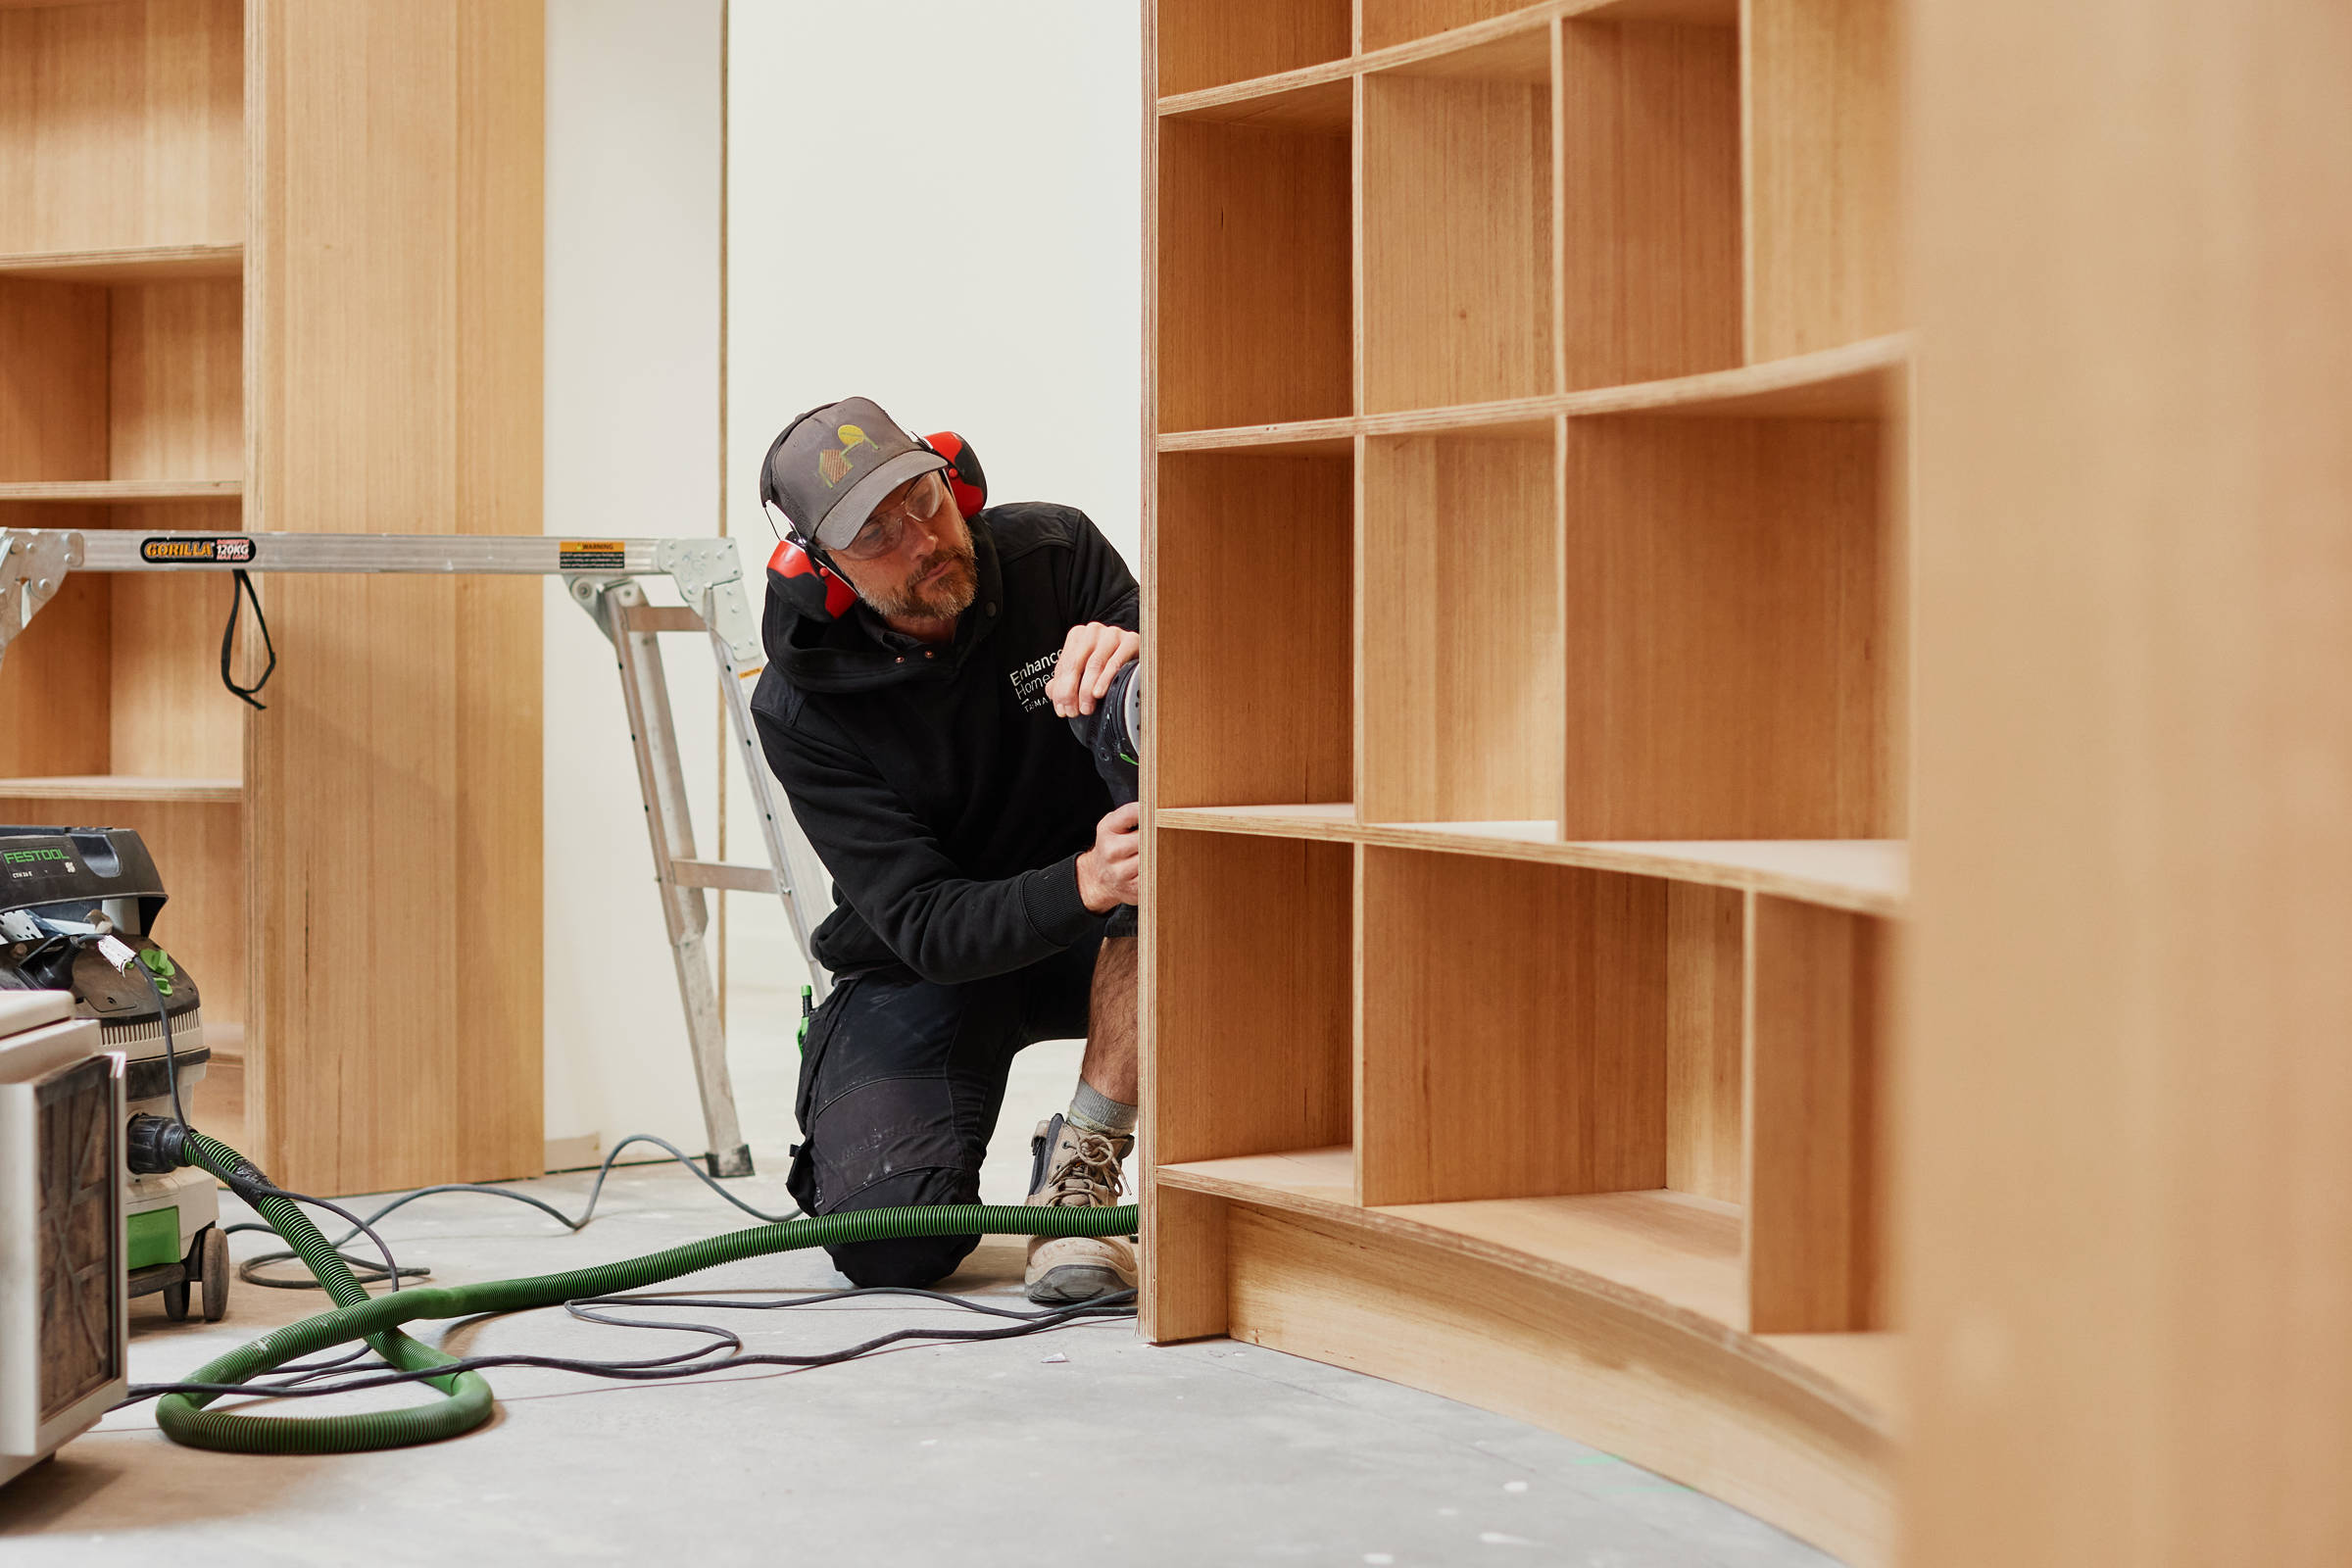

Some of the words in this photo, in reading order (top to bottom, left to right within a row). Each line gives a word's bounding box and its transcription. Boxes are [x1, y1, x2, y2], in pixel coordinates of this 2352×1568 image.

[145, 542, 213, 558] GORILLA
[217, 544, 249, 555] 120KG
[3, 848, 70, 864] FESTOOL
